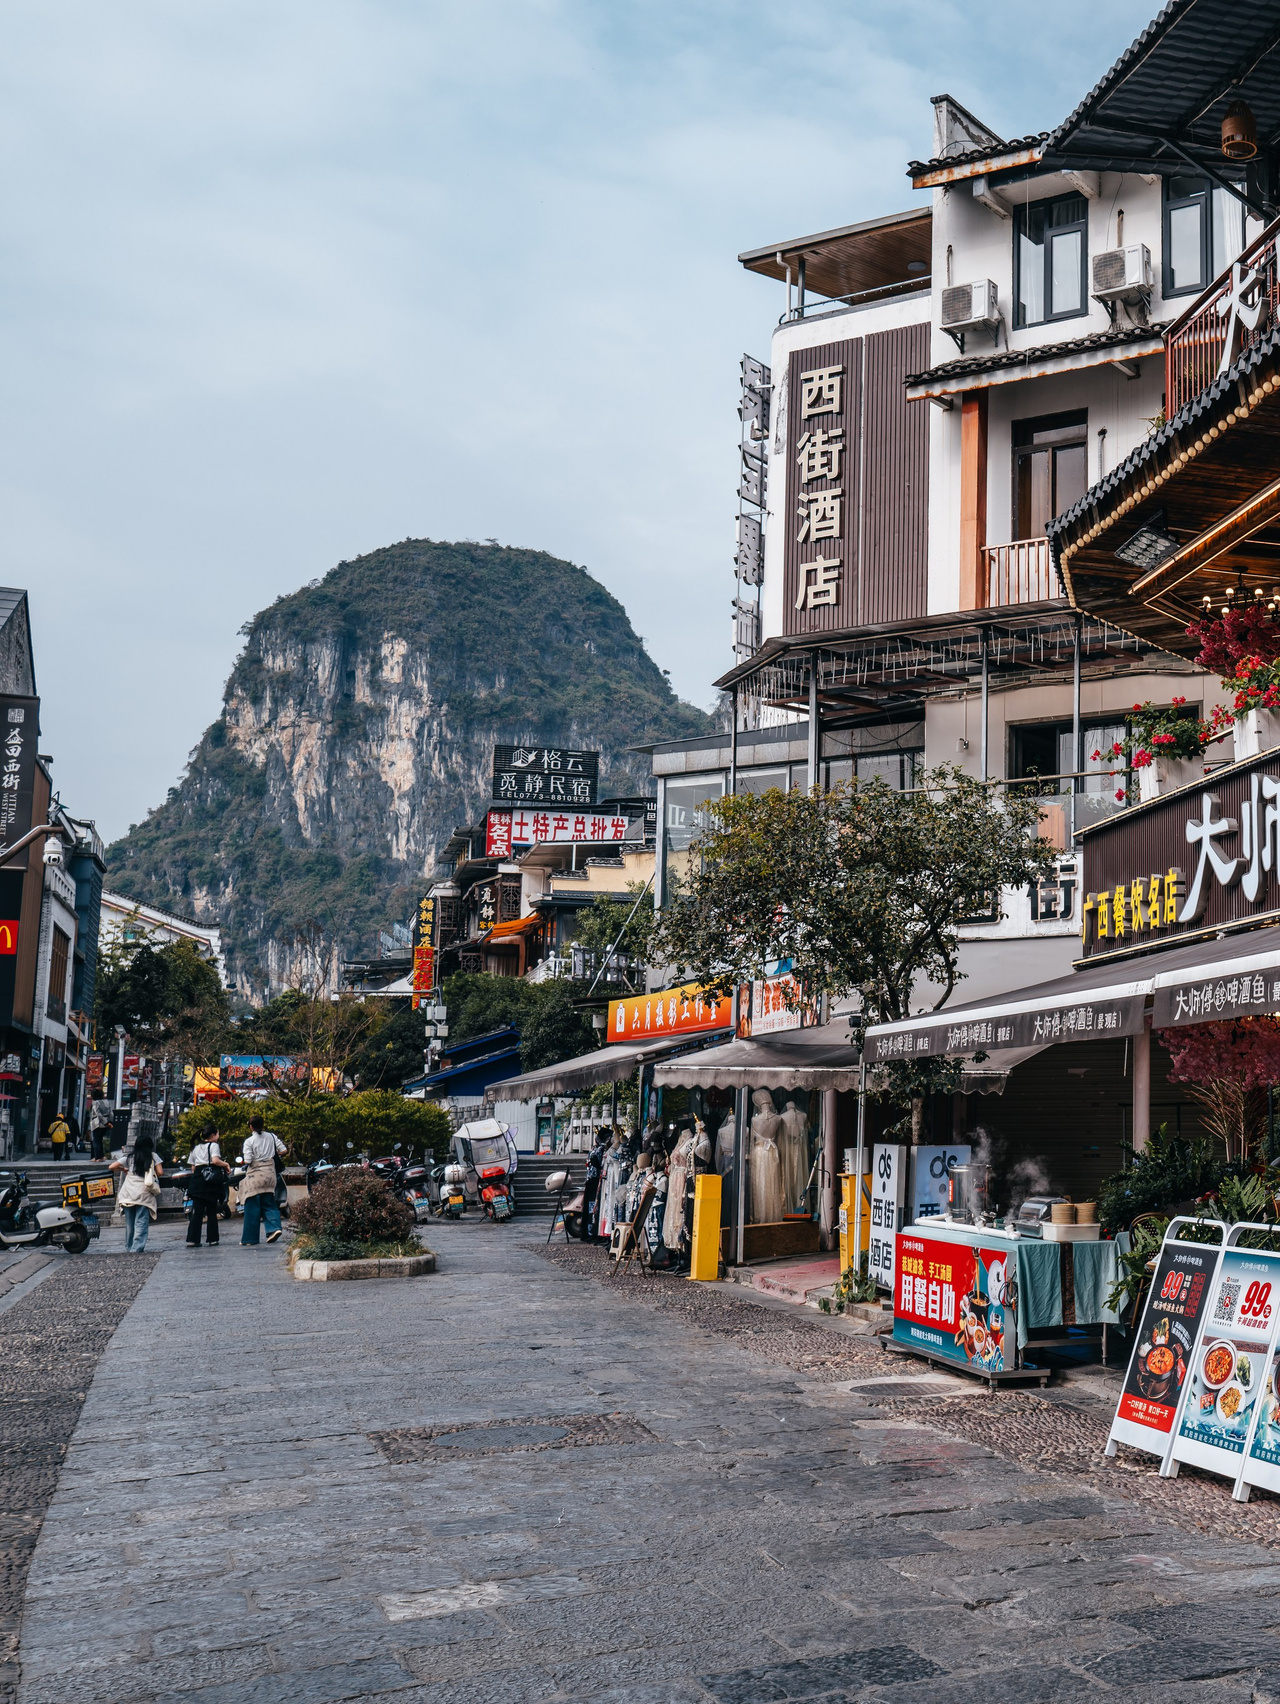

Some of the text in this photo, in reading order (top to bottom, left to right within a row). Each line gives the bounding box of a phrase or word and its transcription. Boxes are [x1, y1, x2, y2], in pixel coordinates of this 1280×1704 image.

[795, 364, 843, 611] 西街酒店
[2, 727, 24, 791] 益田西街
[542, 750, 583, 772] 格云
[500, 773, 591, 797] 觅静民宿
[0, 811, 8, 836] STREET
[8, 793, 17, 824] YITIAN
[489, 814, 512, 825] 桂林
[513, 812, 626, 842] 土特产总批发
[1082, 867, 1180, 946] 广西餐饮名店
[873, 1198, 895, 1229] 西街
[870, 1238, 892, 1270] 酒店
[901, 1273, 956, 1325] 用餐自助
